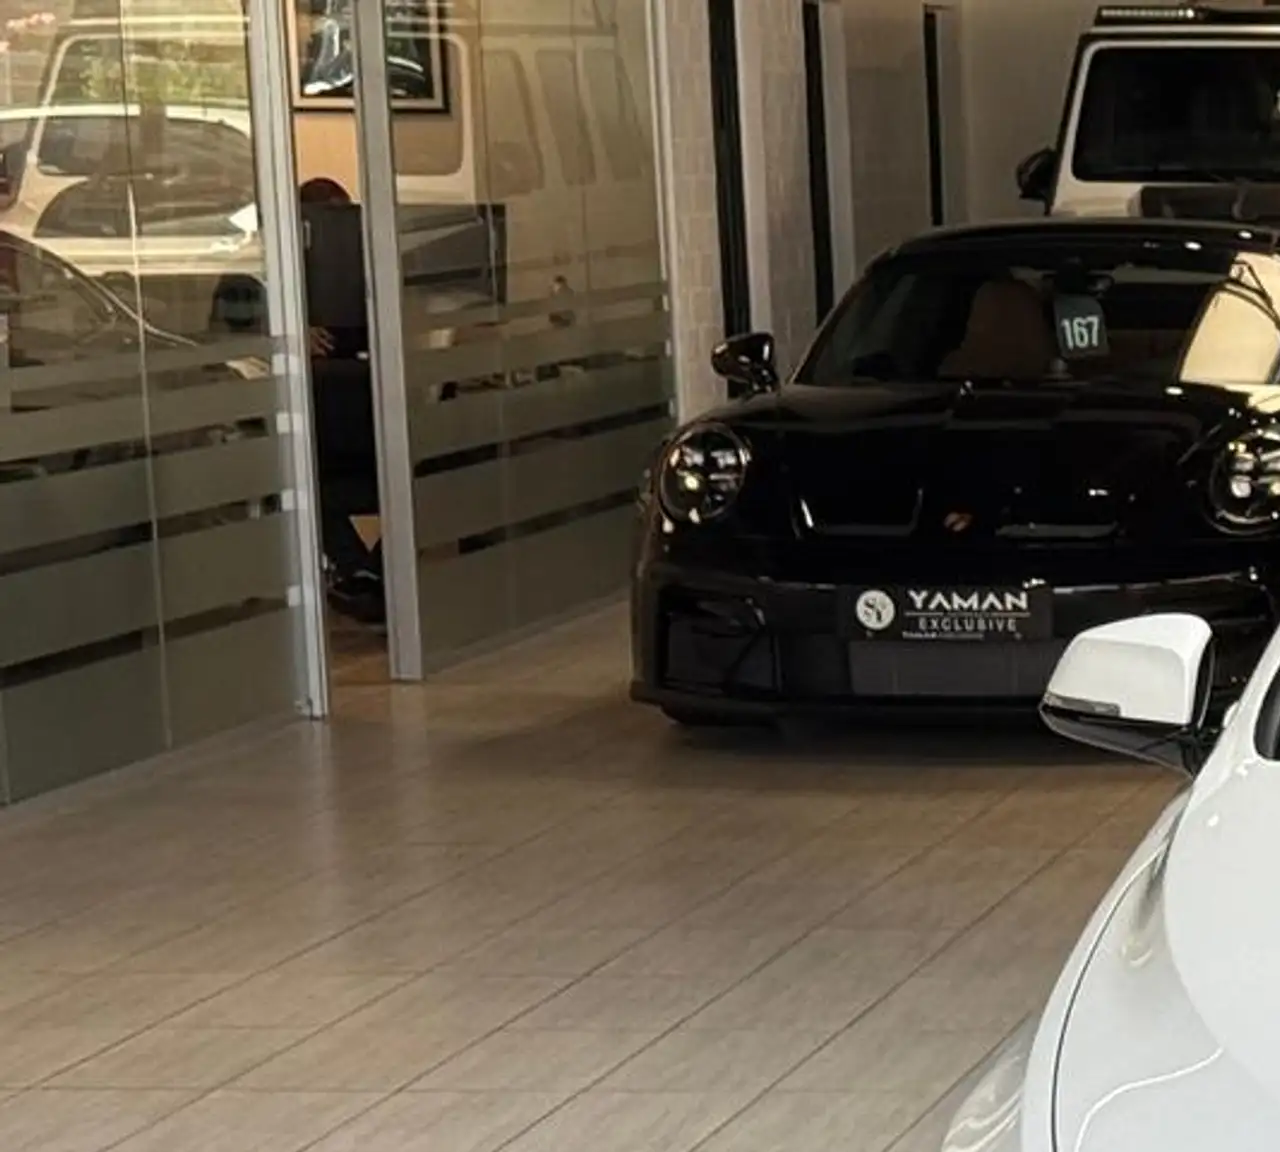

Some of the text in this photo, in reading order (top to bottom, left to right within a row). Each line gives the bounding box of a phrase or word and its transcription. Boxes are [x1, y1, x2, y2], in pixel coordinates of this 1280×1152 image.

[1061, 315, 1099, 350] 167
[907, 590, 1029, 611] YAMAN
[918, 616, 1017, 632] EXCLUSIVE
